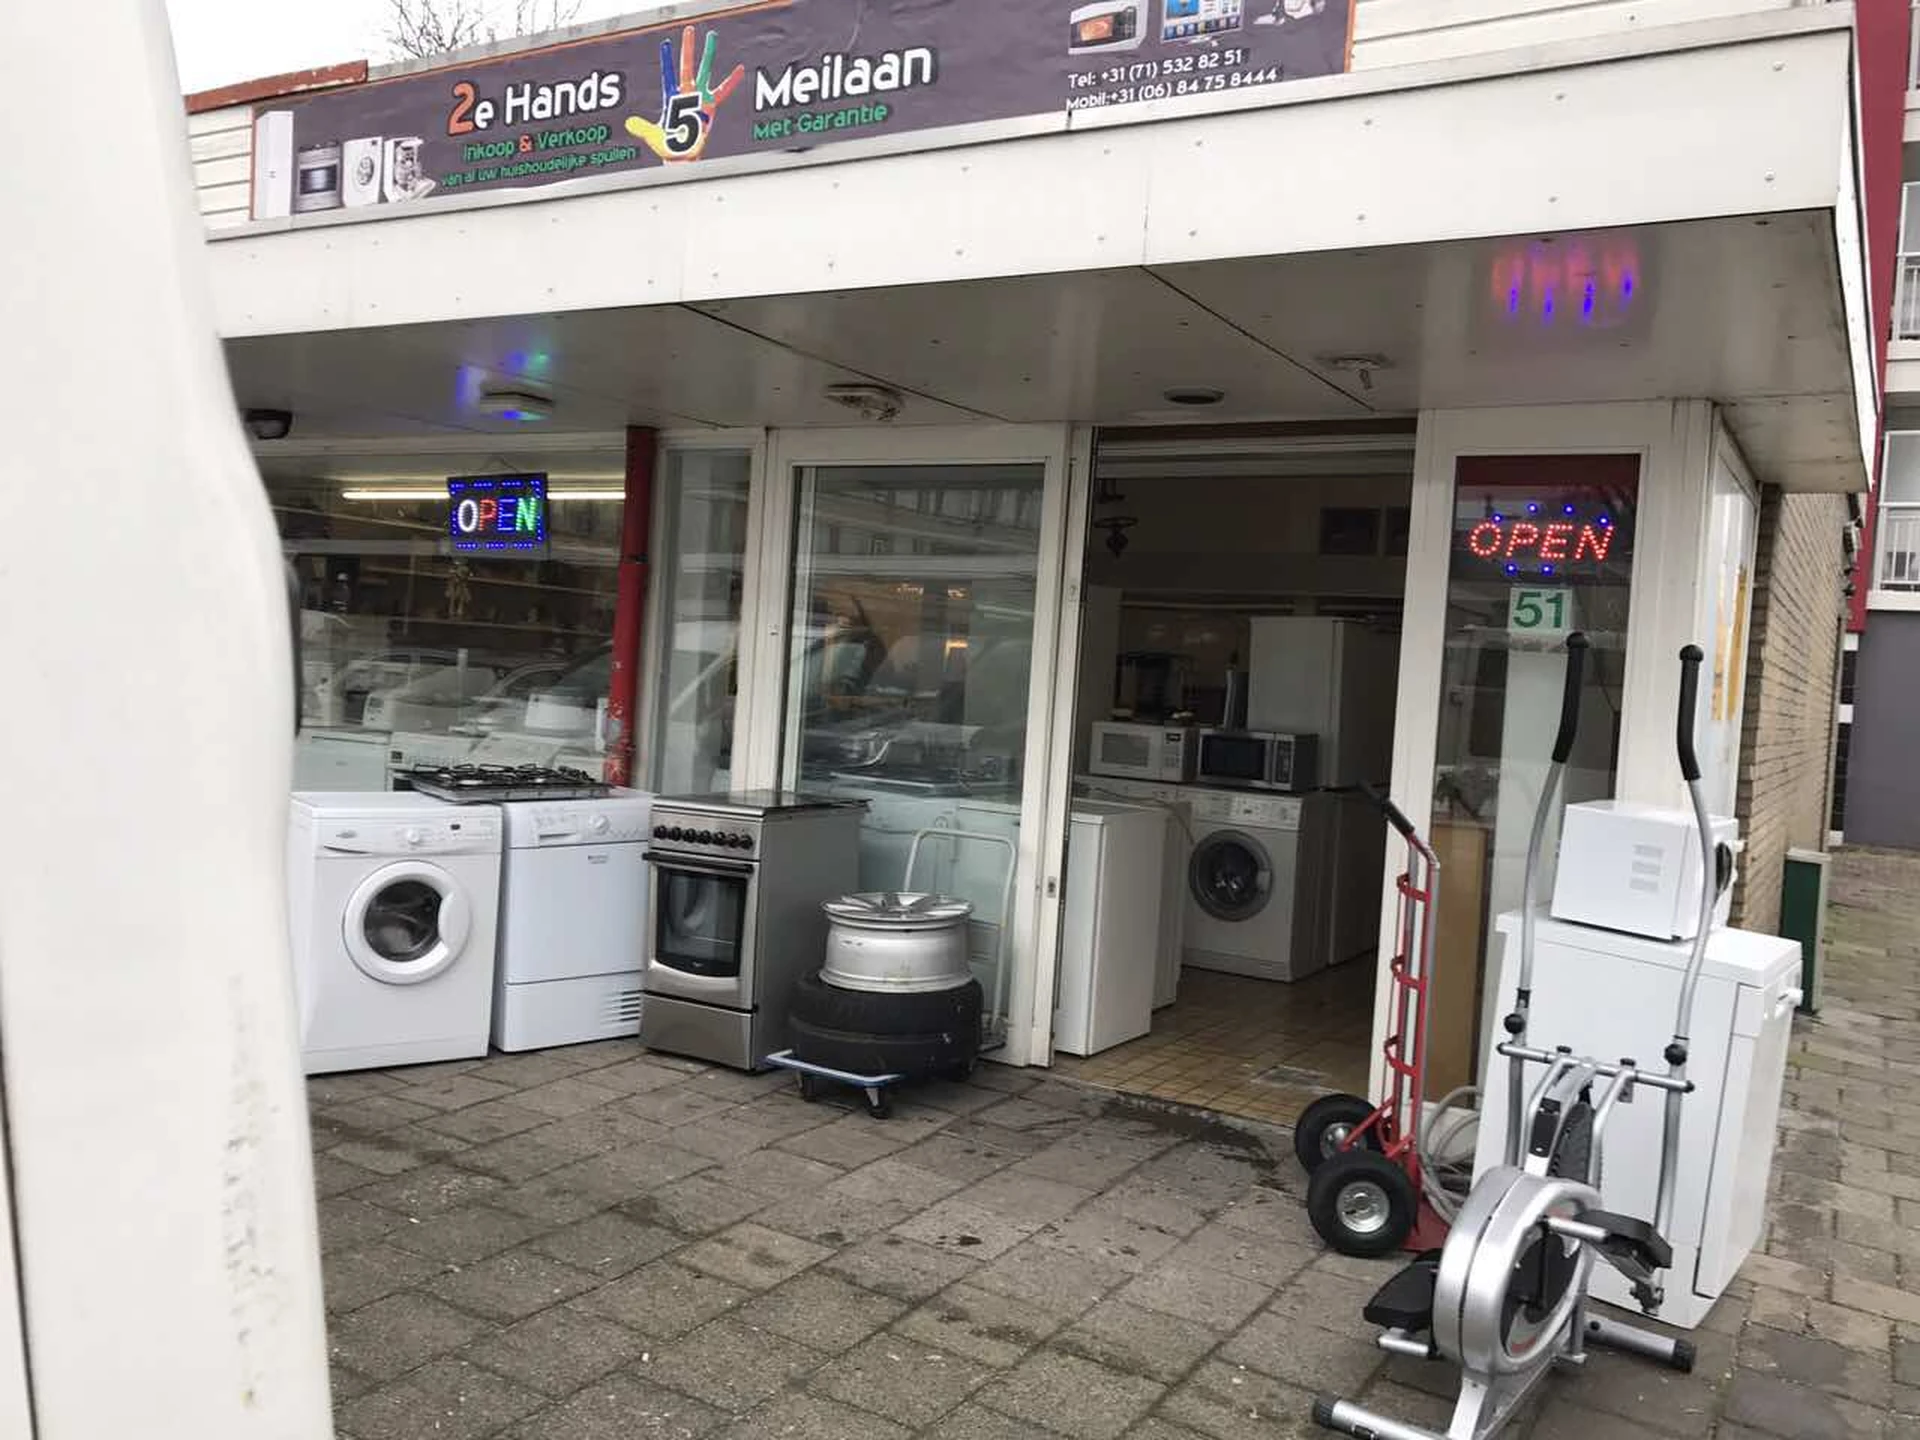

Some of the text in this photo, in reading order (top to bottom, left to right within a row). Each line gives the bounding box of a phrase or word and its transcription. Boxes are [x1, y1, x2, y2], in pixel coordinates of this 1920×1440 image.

[755, 47, 931, 111] Meilaan
[1068, 49, 1242, 89] Tel: +31 (71) 532 82 51
[1138, 82, 1172, 101] (06)
[1176, 79, 1198, 94] 84
[1204, 74, 1225, 90] 75
[1229, 67, 1277, 87] 8444
[448, 71, 621, 135] 2e Hands
[753, 102, 888, 140] Met Garantie
[663, 91, 702, 156] 5
[463, 126, 608, 161] Inkoop & Verkoop
[442, 172, 463, 187] van
[457, 497, 537, 533] OPEN
[1469, 521, 1615, 561] OPEN
[1512, 590, 1564, 628] 51
